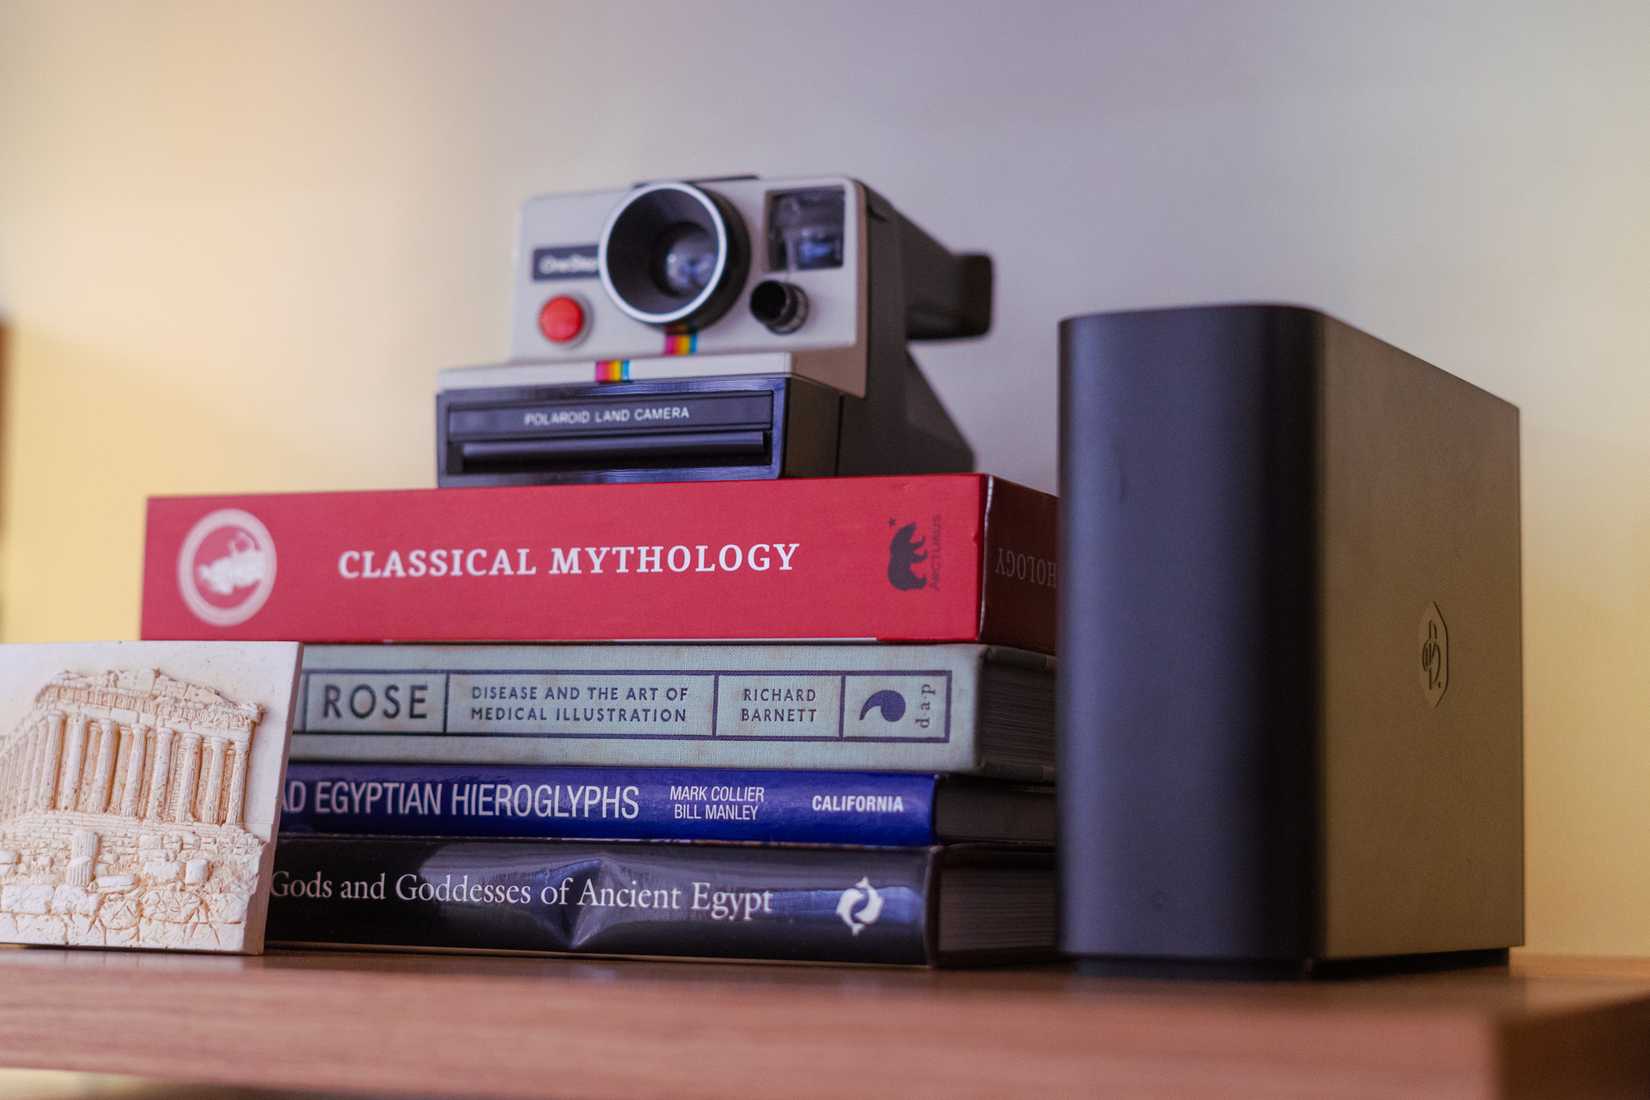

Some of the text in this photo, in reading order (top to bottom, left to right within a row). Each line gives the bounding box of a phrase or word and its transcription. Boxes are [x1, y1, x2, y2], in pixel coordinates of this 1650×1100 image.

[523, 405, 691, 425] POLAROID LAND CAMERA
[338, 542, 801, 579] CLASSICAL MYTHOLOGY
[322, 683, 429, 720] ROSE
[471, 686, 689, 702] DISEASE AND THE ART OF
[743, 688, 817, 703] RICHARD
[471, 707, 687, 724] MEDICAL ILLUSTRATION
[740, 708, 818, 724] BARNETT
[315, 781, 442, 815] EGYPTIAN
[451, 783, 640, 820] HIEROGLYPHS
[669, 786, 765, 802] MARK COLLIER
[674, 804, 759, 821] BILL MANLEY
[811, 794, 905, 813] CALIFORNIA
[271, 869, 774, 922] Gods and Goddesses of Ancient Egypt
